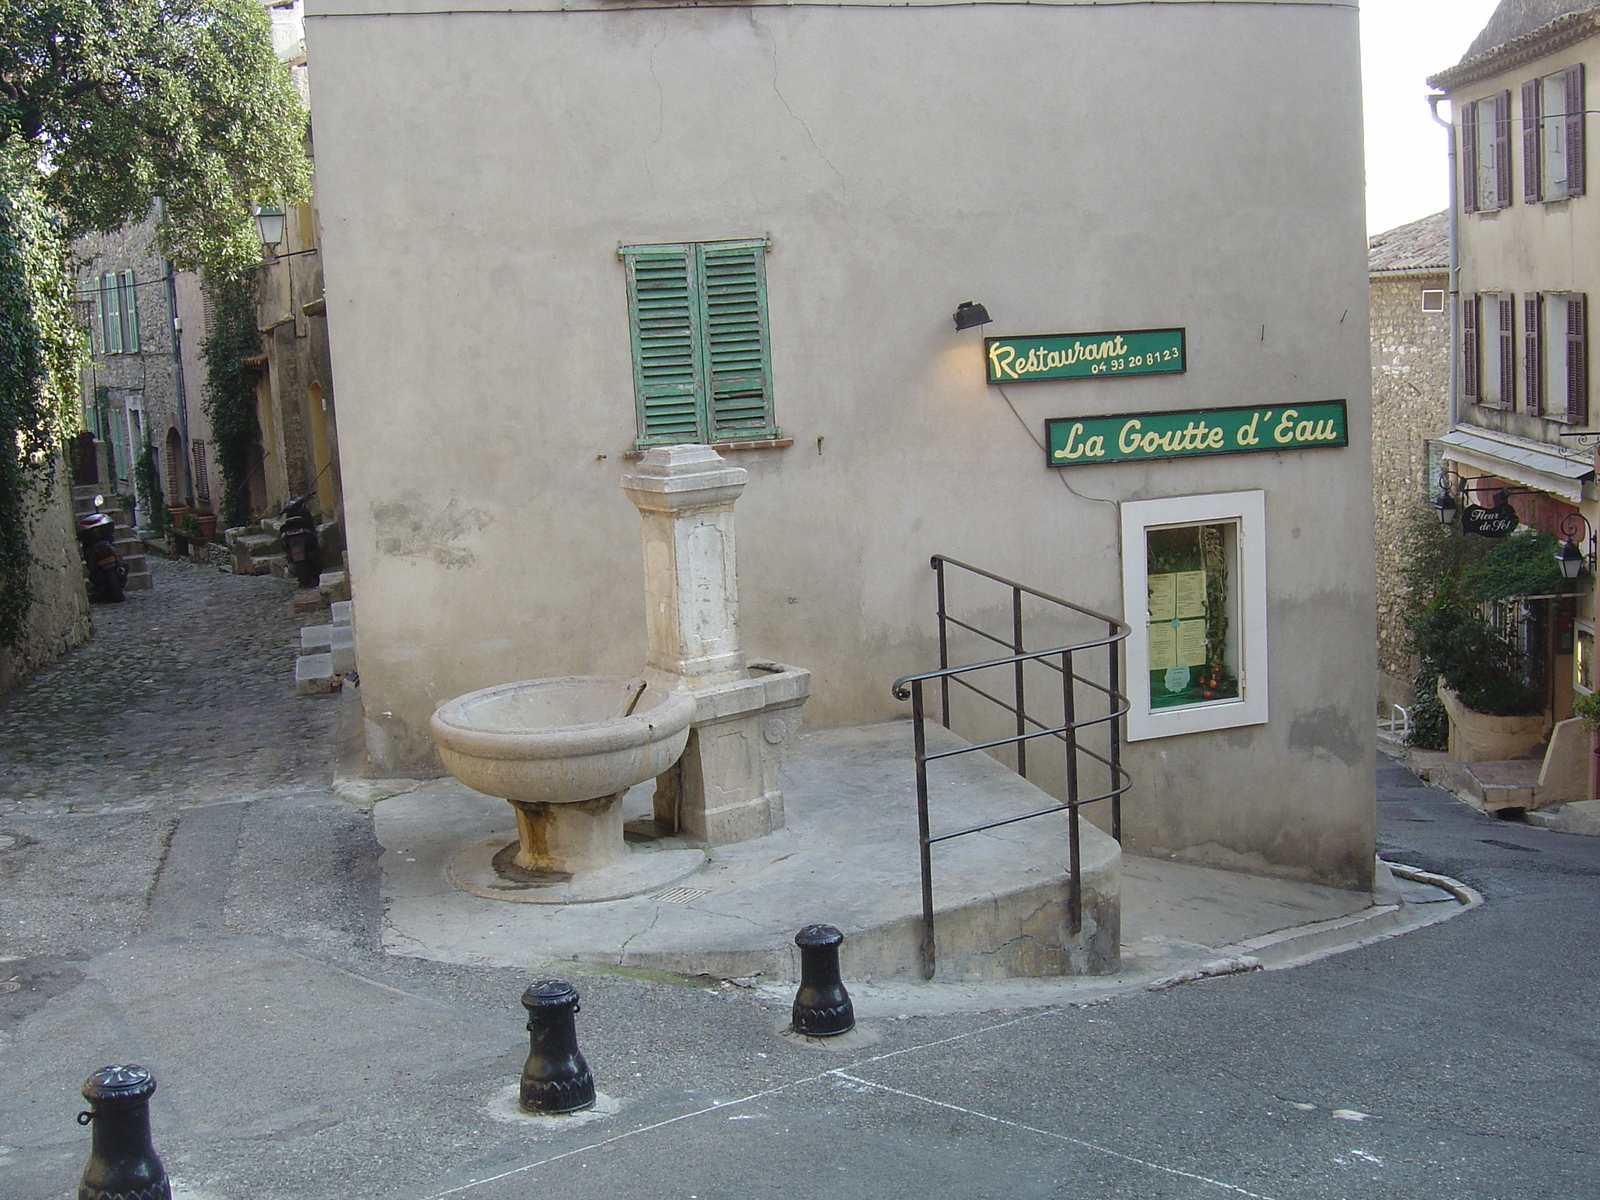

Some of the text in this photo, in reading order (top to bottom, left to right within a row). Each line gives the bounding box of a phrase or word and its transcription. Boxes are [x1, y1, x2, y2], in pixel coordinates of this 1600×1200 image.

[989, 335, 1128, 379] Restaurant
[1091, 361, 1107, 374] 04
[1110, 358, 1125, 371] 93
[1128, 355, 1143, 368] 20
[1054, 409, 1337, 459] La Goutte d'Eau
[1470, 509, 1500, 522] Fleur
